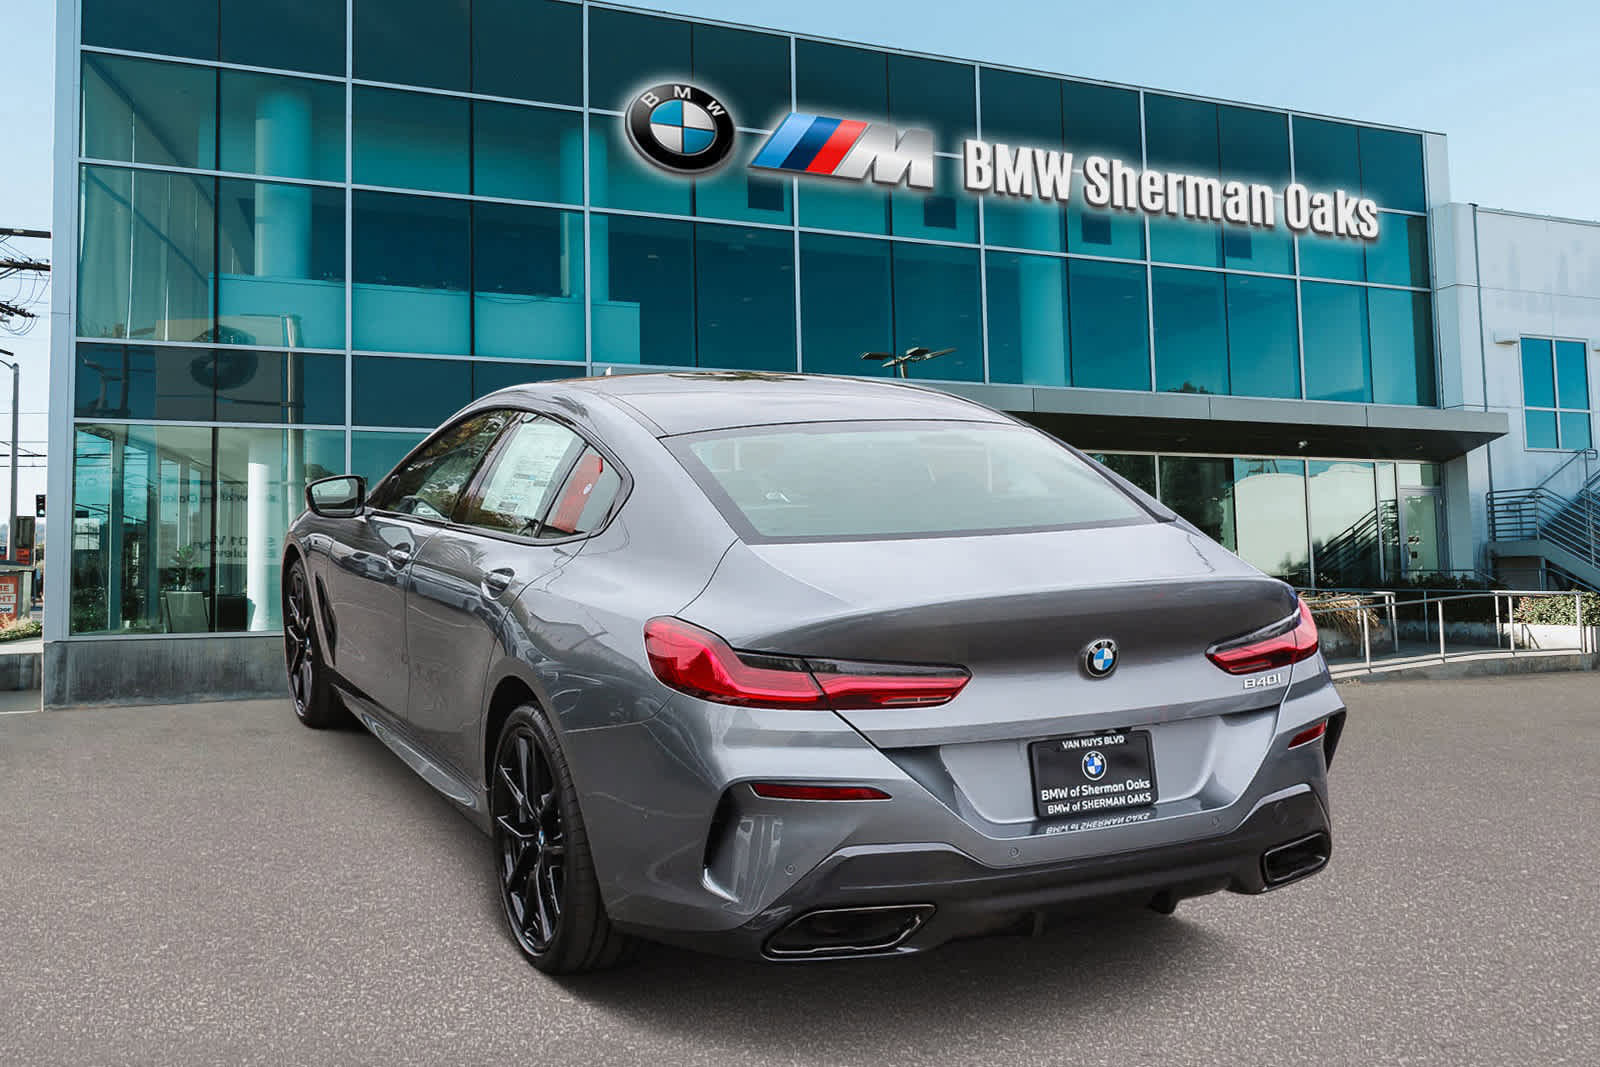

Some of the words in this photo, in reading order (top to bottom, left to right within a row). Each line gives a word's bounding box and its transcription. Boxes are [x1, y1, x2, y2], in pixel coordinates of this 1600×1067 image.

[640, 84, 726, 118] BMW
[832, 121, 935, 189] M
[963, 138, 1073, 202] BMW
[1083, 155, 1276, 227] Sherman
[1283, 182, 1380, 242] Oaks
[1062, 740, 1080, 749] VAN
[1081, 737, 1103, 747] NUYS
[1104, 735, 1125, 745] BLVD
[1041, 787, 1069, 800] BMW
[1070, 786, 1080, 797] of
[1081, 783, 1125, 796] Sherman
[1126, 779, 1151, 789] Oaks
[1047, 803, 1071, 815] BMW
[1072, 801, 1081, 811] of
[1083, 797, 1126, 810] SHERMAN
[1127, 792, 1152, 804] OAKS
